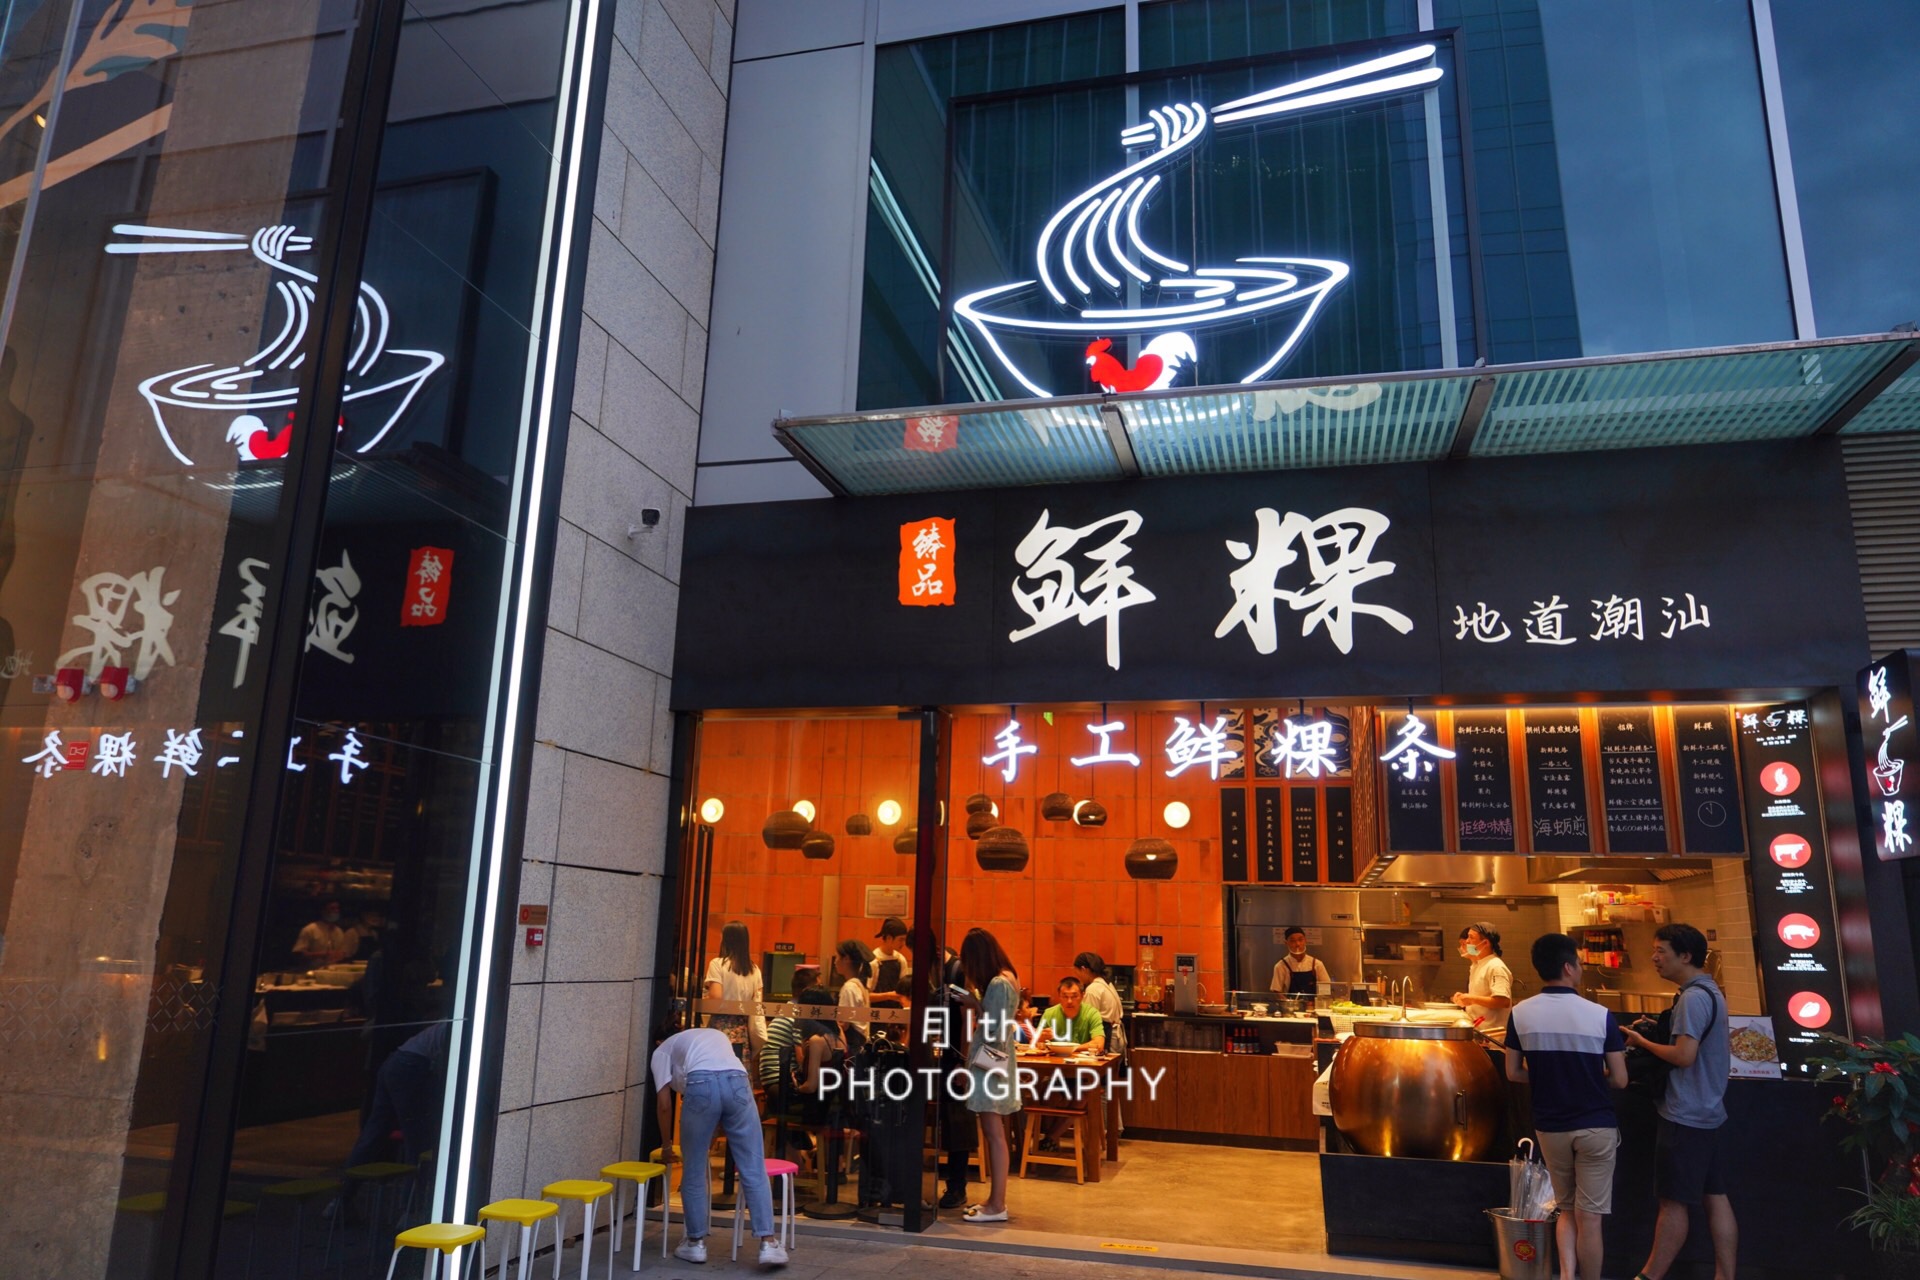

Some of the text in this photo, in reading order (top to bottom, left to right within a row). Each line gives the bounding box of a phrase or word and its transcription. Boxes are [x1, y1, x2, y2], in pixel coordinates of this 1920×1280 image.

[1009, 507, 1413, 670] 鲜粿
[1453, 593, 1710, 646] 地道潮汕
[982, 714, 1456, 783] 手工鲜粿条
